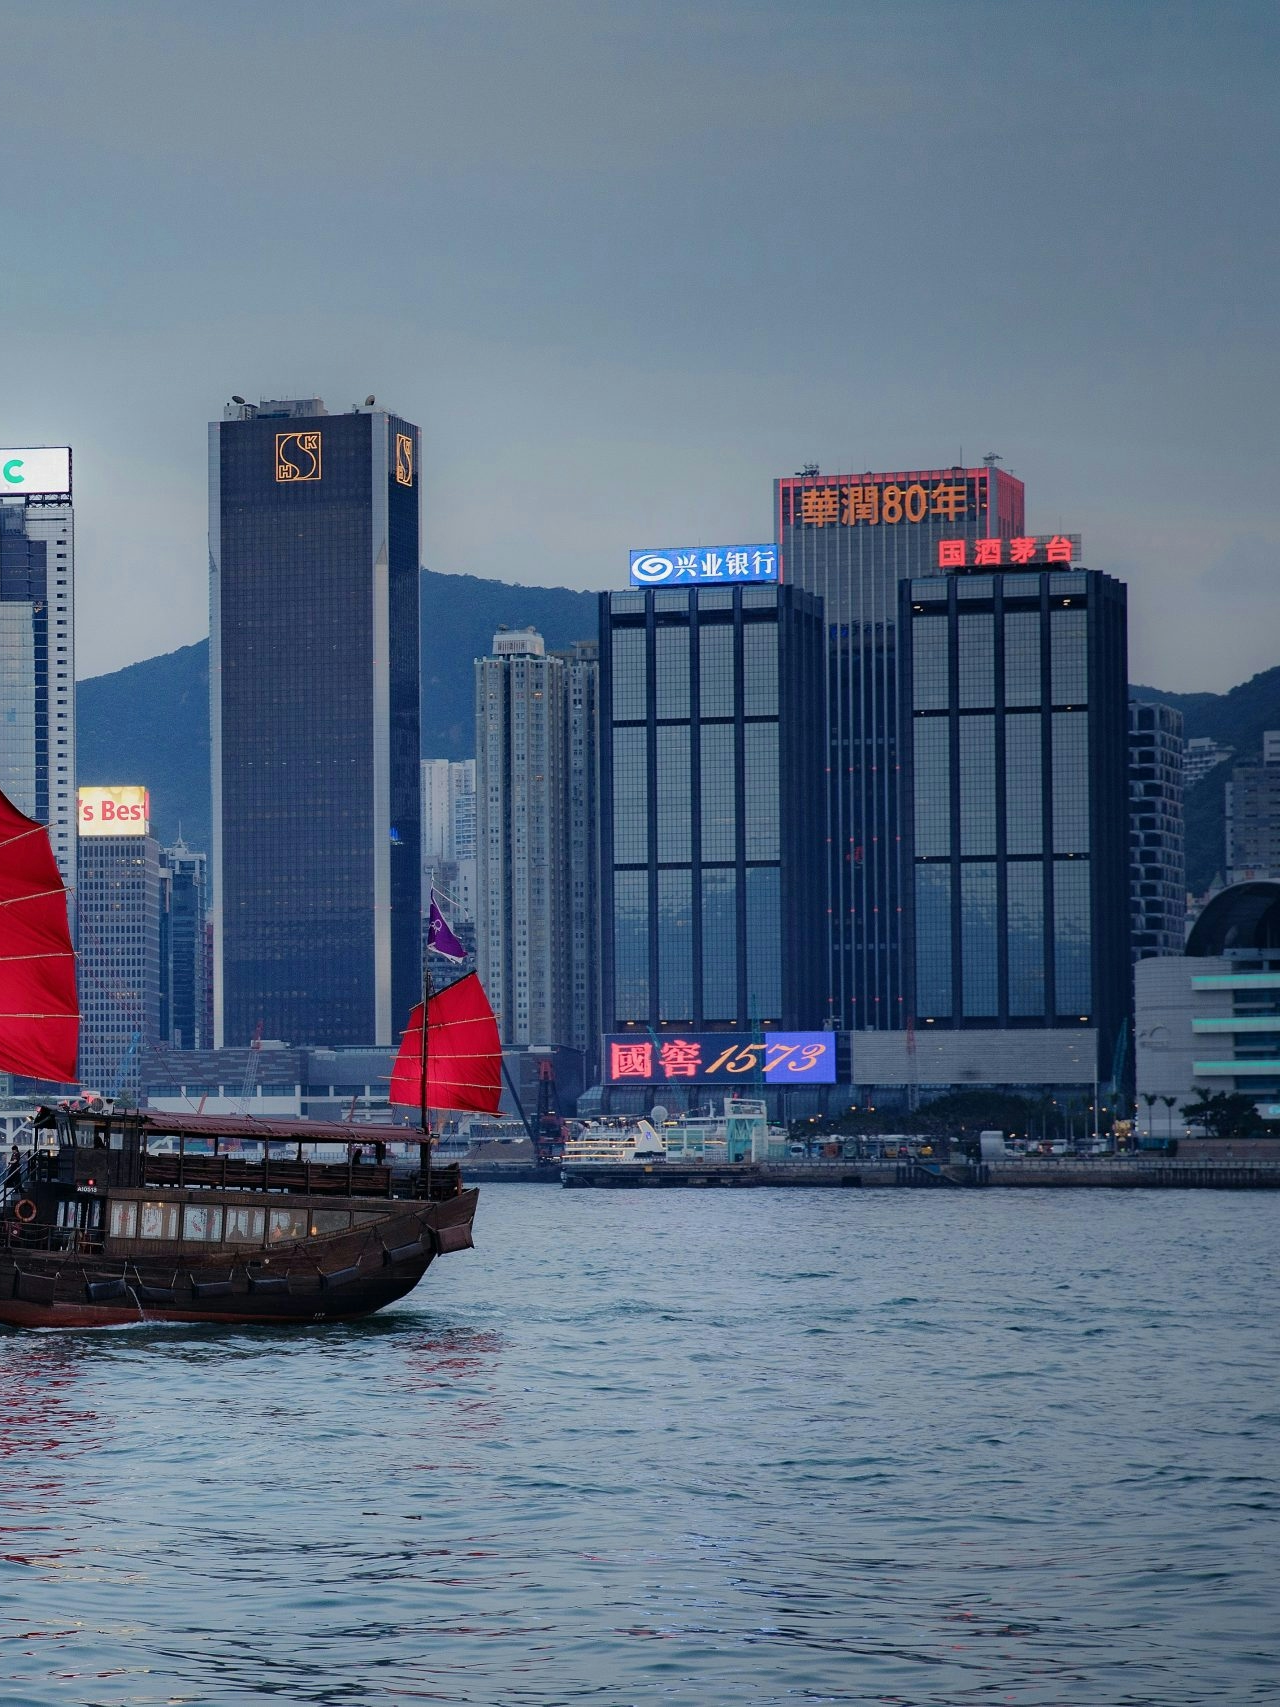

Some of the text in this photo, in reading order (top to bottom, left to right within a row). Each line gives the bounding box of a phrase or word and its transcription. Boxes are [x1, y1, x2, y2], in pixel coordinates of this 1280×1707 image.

[3, 459, 25, 484] C
[801, 482, 968, 528] 華潤80年
[674, 550, 775, 577] 兴业银行
[939, 535, 1073, 567] 国酒茅台
[611, 1039, 702, 1080] 國窖
[705, 1043, 826, 1074] 1573
